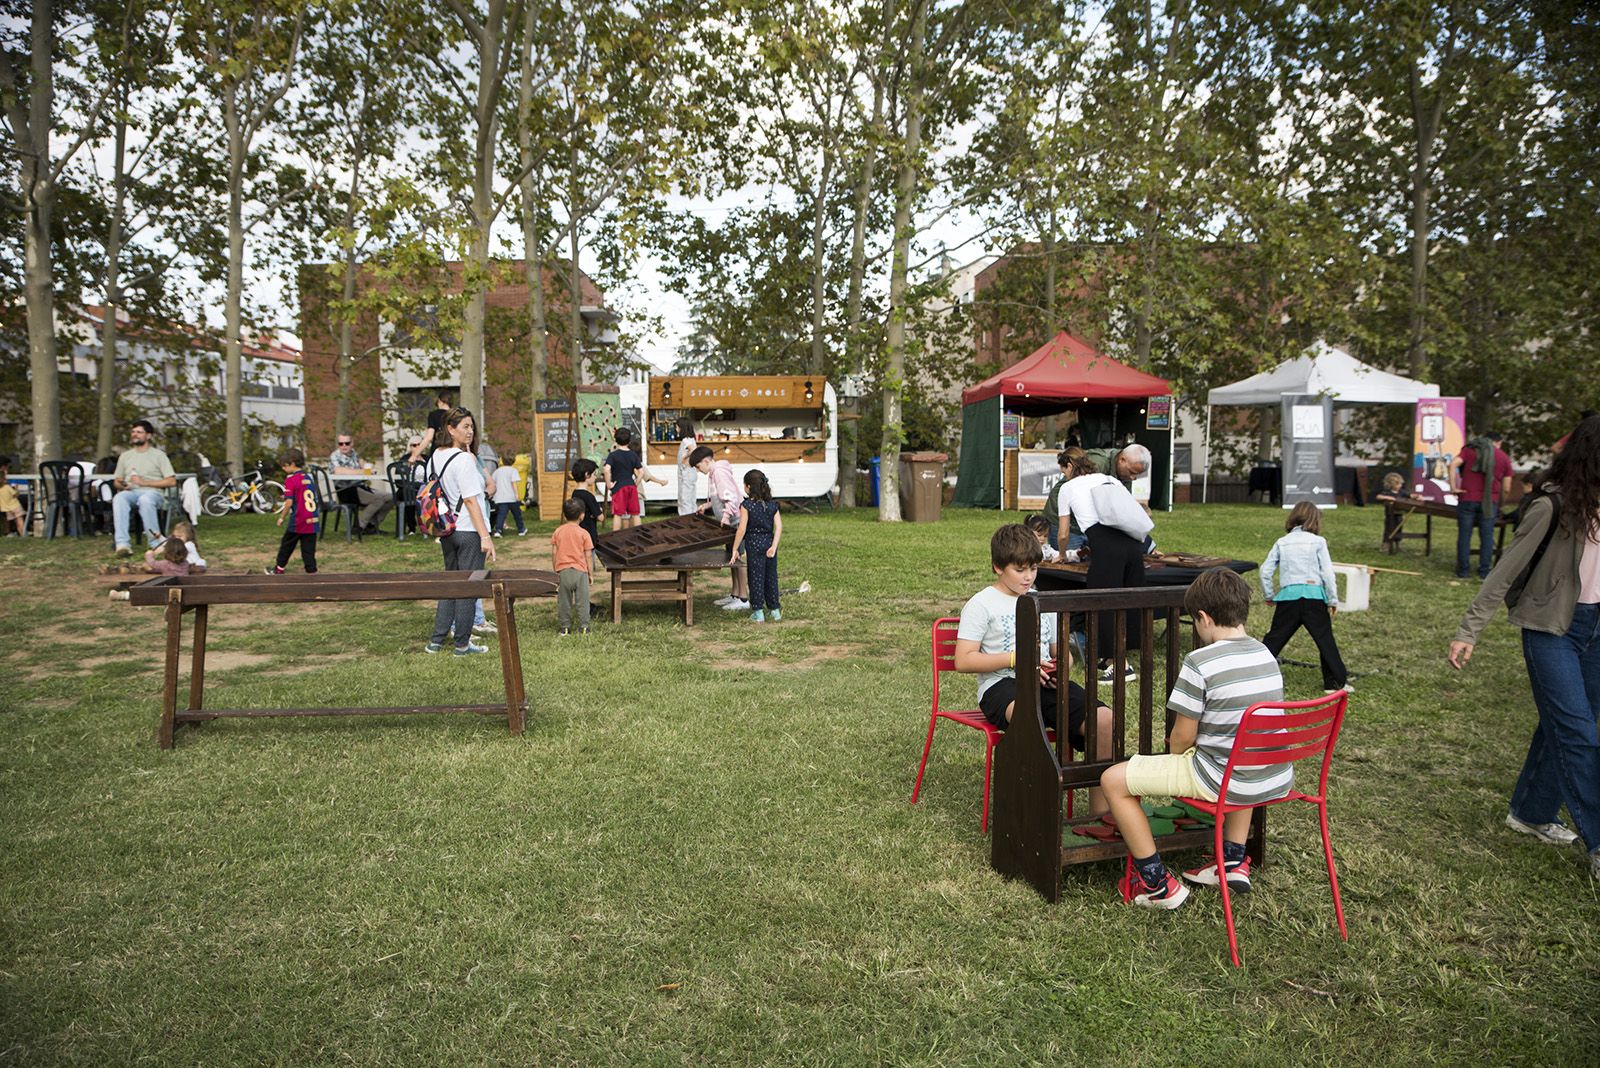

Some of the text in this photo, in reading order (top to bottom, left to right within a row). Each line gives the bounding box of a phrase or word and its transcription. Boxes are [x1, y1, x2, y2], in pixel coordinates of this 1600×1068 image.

[690, 388, 786, 397] STREET ROLS
[1295, 422, 1321, 435] PUA
[303, 489, 316, 513] 8
